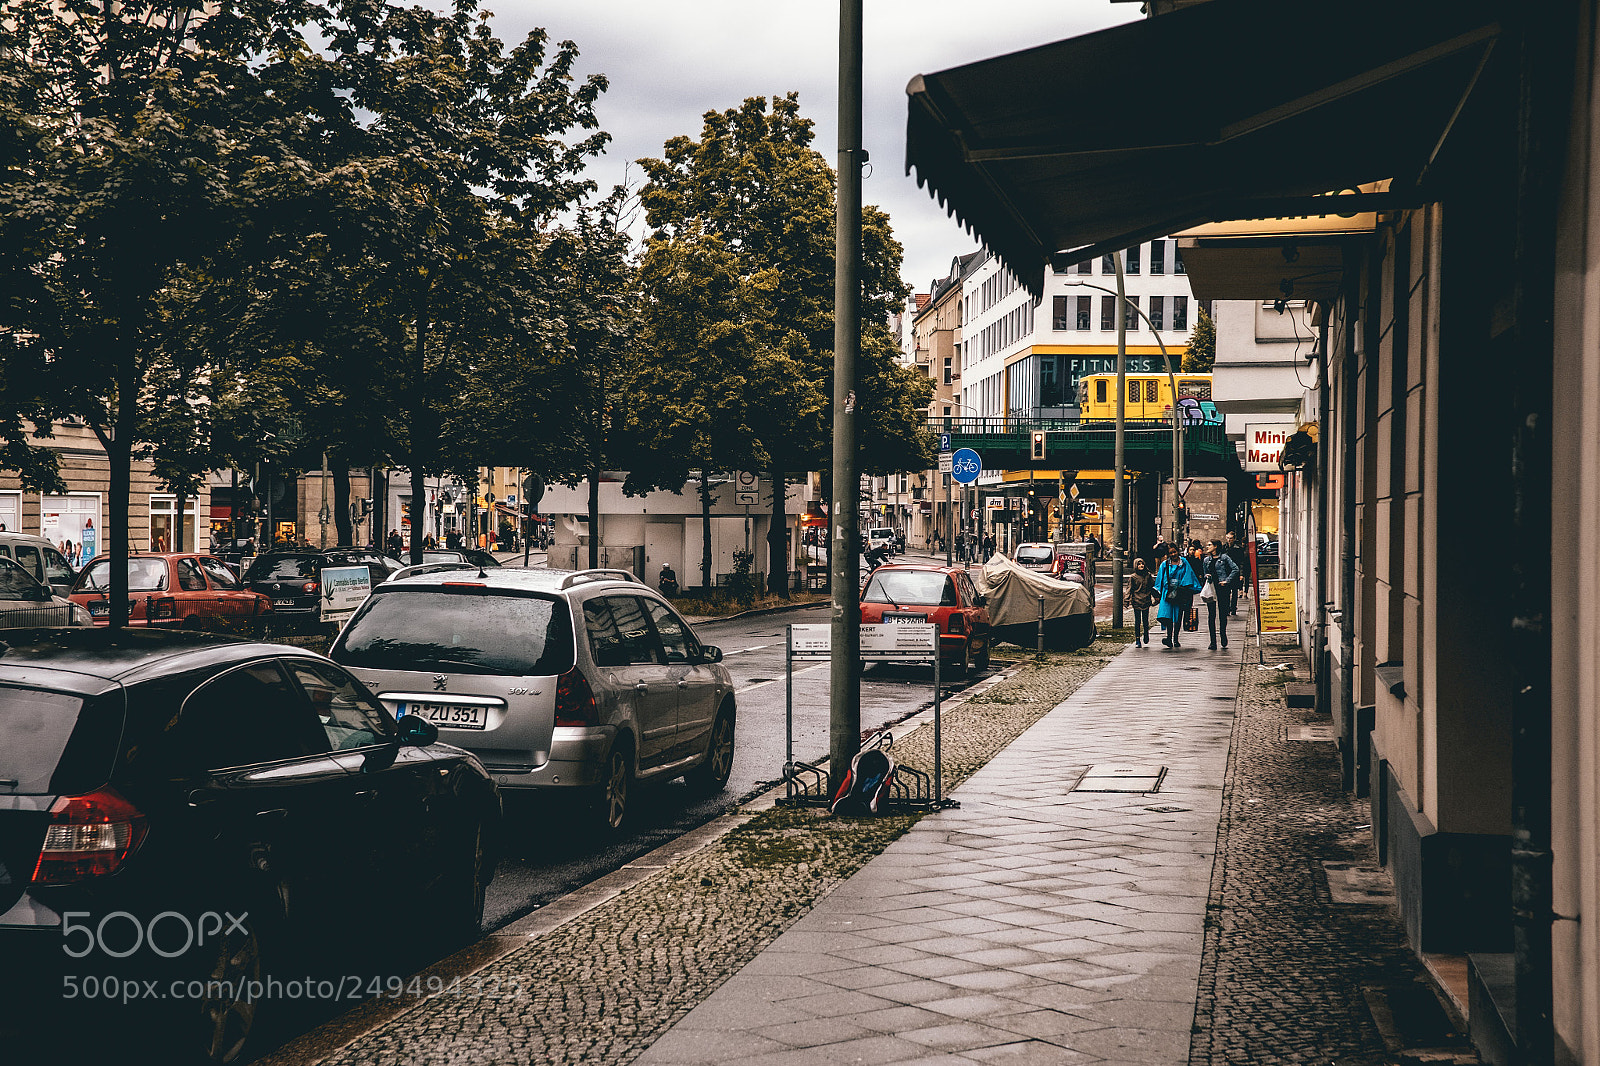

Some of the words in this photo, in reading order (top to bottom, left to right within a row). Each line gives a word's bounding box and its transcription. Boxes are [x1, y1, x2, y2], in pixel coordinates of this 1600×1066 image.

[1071, 359, 1150, 372] FITNSS
[1255, 430, 1286, 444] Mini
[508, 687, 528, 695] 307
[411, 704, 420, 715] B
[430, 706, 450, 721] ZU
[452, 707, 479, 723] 351
